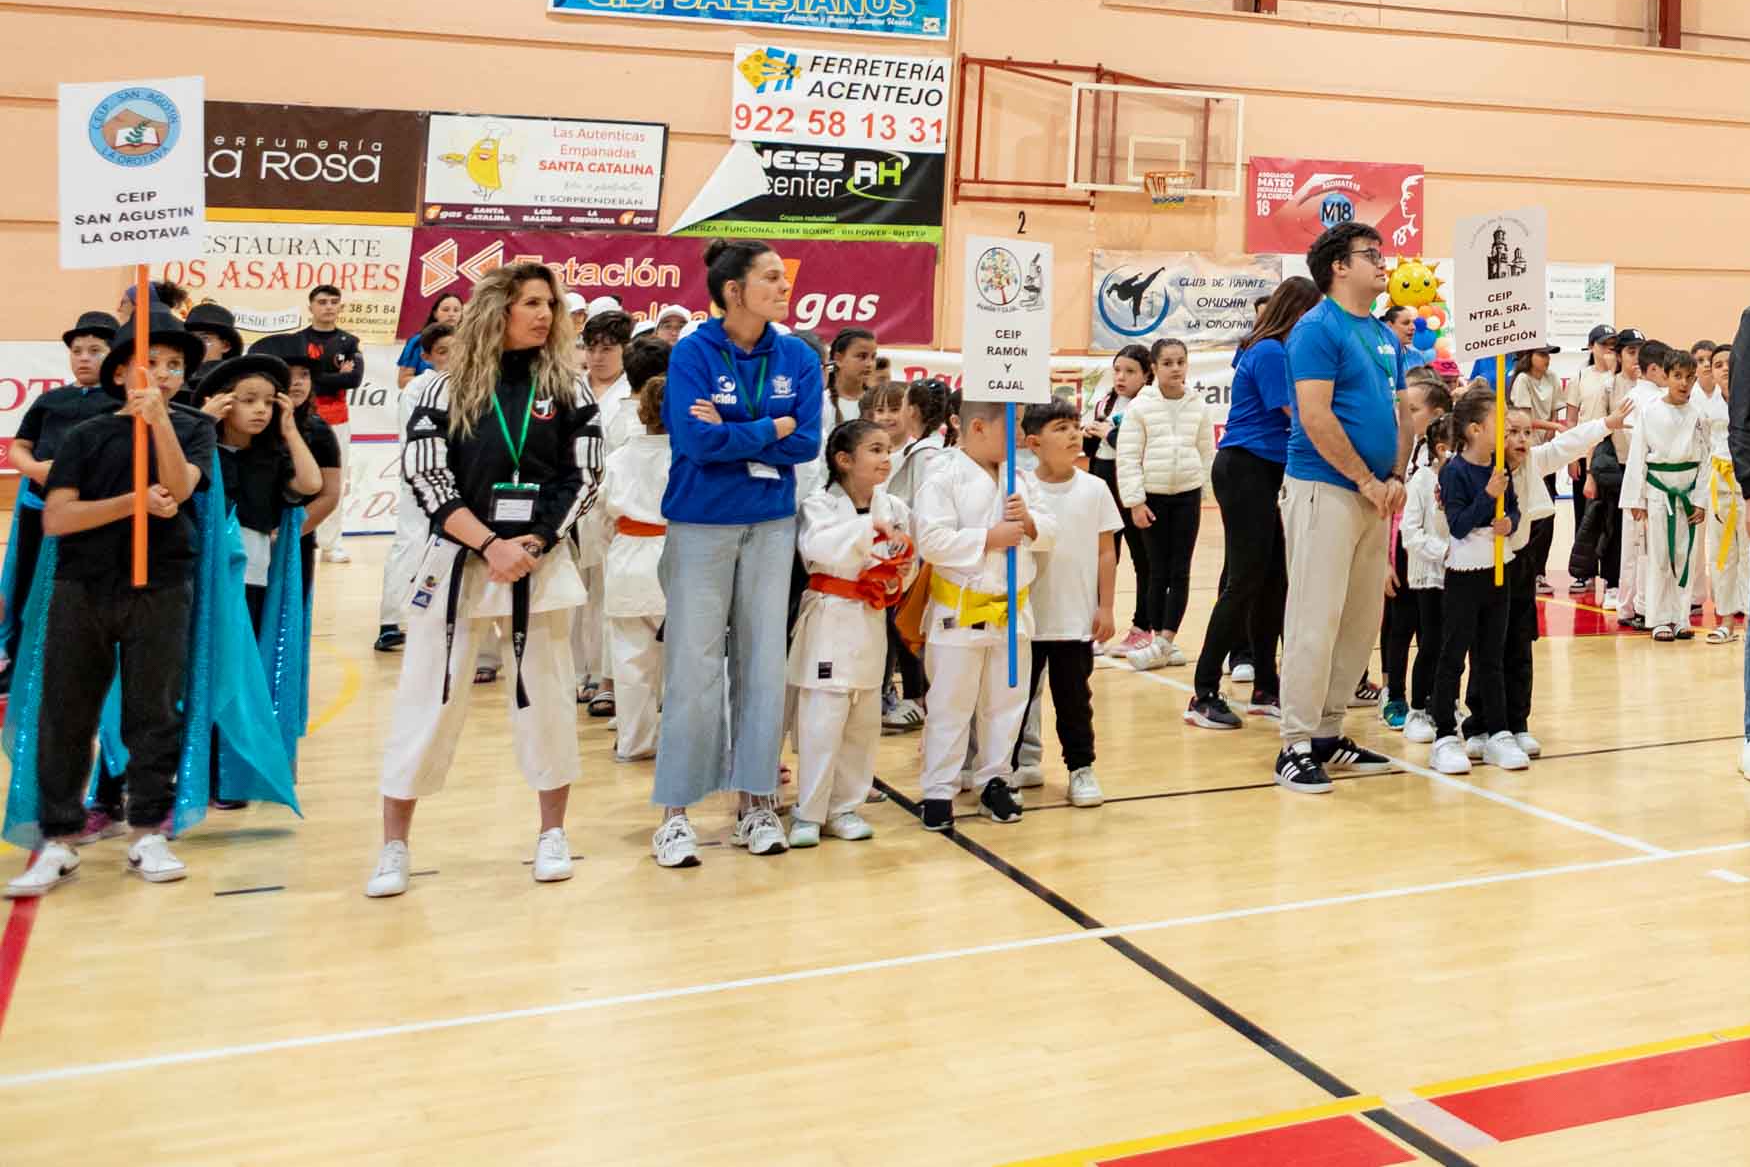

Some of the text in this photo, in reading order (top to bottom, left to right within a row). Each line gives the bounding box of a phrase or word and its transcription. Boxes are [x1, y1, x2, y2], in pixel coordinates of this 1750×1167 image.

[809, 56, 945, 83] FERRETERÍA
[807, 80, 943, 107] ACENTEJO
[735, 103, 944, 144] 922 58 13 31
[553, 126, 575, 140] Las
[560, 144, 636, 160] Empanadas
[538, 160, 654, 176] SANTA CATALINA
[1257, 177, 1294, 187] MATEO
[116, 191, 157, 204] CEIP
[75, 206, 194, 225] SAN AGUSTIN
[1256, 200, 1270, 216] 18
[688, 225, 718, 233] UERZA
[724, 225, 775, 234] FUNCIONAL
[1017, 210, 1026, 234] 2
[81, 226, 190, 245] LA OROTAVA
[1392, 229, 1406, 247] 18
[163, 259, 401, 292] OS ASADORES
[1179, 277, 1207, 287] CLUB
[1212, 278, 1225, 287] DE
[1488, 290, 1512, 303] CEIP
[350, 304, 396, 314] 38 51 84
[795, 293, 880, 330] gas
[1469, 302, 1531, 321] NTRA. SRA.
[1187, 320, 1200, 329] LA
[1485, 320, 1516, 333] DE LA
[995, 329, 1022, 339] CEIP
[1465, 330, 1537, 352] CONCEPCIÓN
[1004, 363, 1012, 373] Y
[988, 380, 1025, 390] CAJAL
